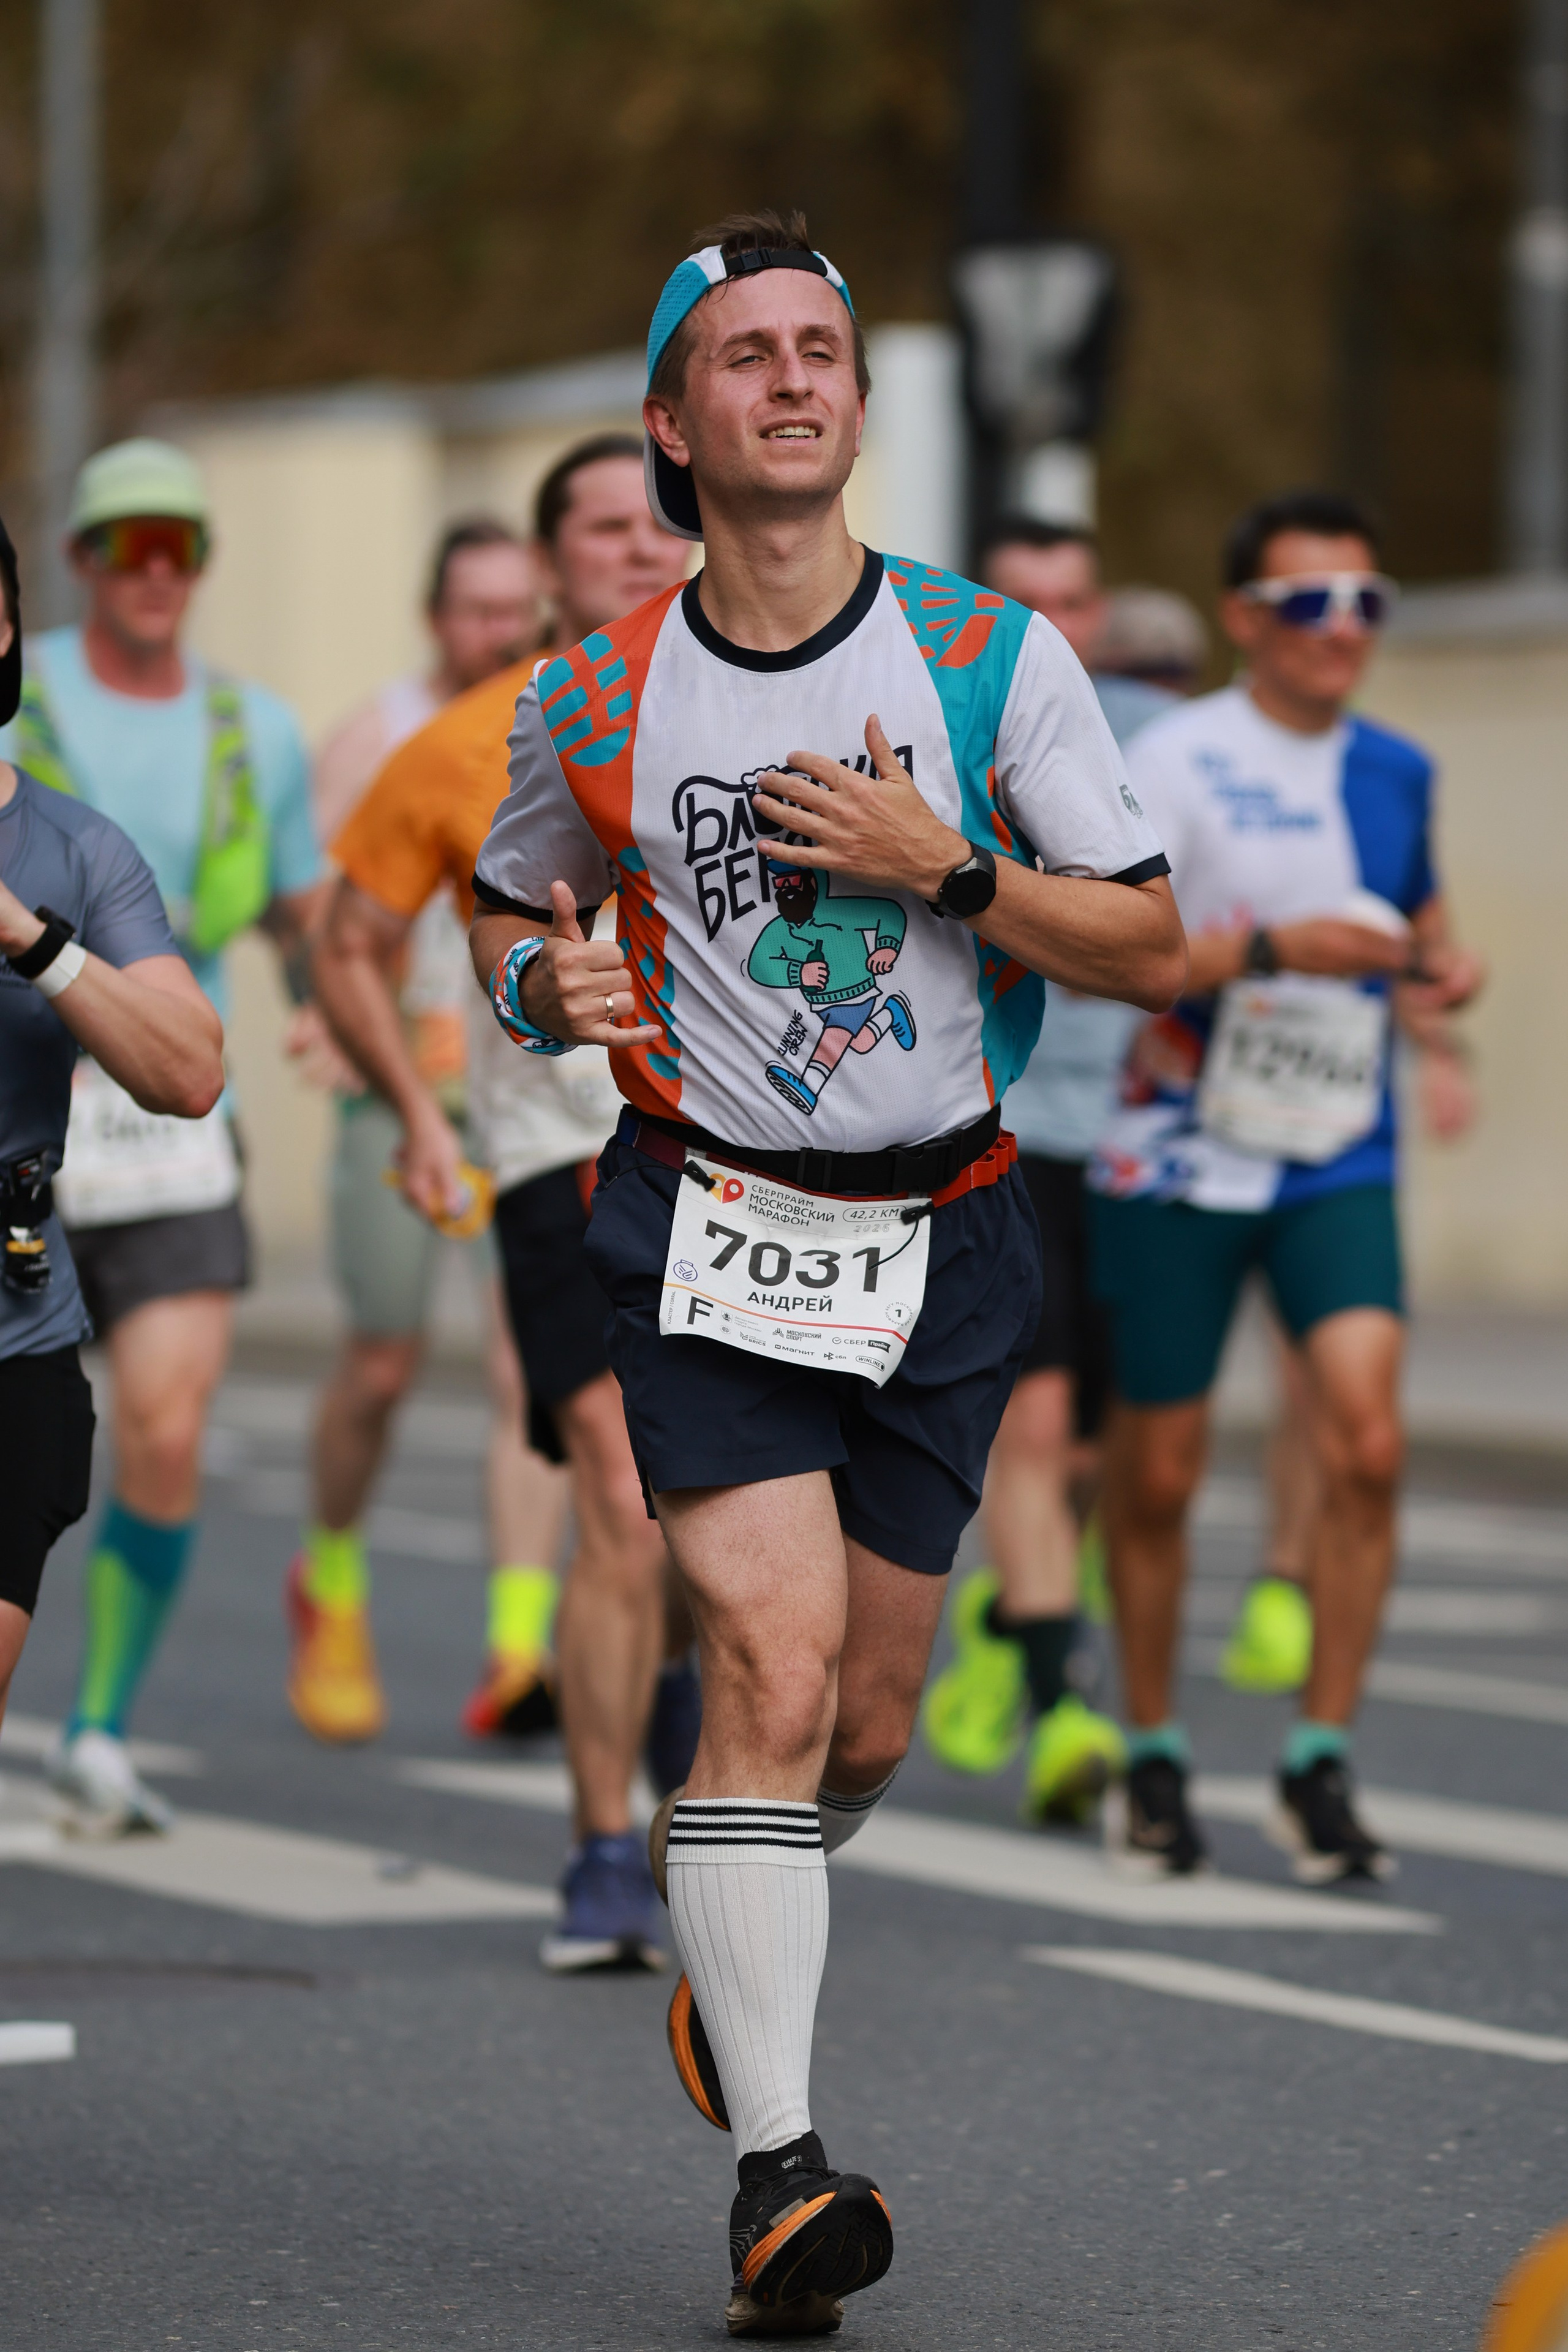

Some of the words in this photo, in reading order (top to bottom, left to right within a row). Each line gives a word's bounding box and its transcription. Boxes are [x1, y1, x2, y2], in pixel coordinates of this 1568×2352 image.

[788, 1023, 808, 1056] CREW
[752, 1185, 814, 1207] СБЕРПРАЙМ
[748, 1204, 810, 1226] МАРАФОН
[750, 1194, 835, 1223] МОСКОВСКИЙ
[850, 1210, 876, 1221] 42,2
[880, 1208, 900, 1218] КМ
[853, 1224, 890, 1232] 2026
[705, 1219, 881, 1293] 7031
[687, 1295, 714, 1325] F
[747, 1291, 833, 1312] АНДРЕЙ
[895, 1309, 902, 1317] 1
[786, 1330, 822, 1339] МОСКОВСКИЙ
[782, 1346, 815, 1356] магнит
[870, 1341, 888, 1350] Прайм
[858, 1356, 881, 1368] WINLINE
